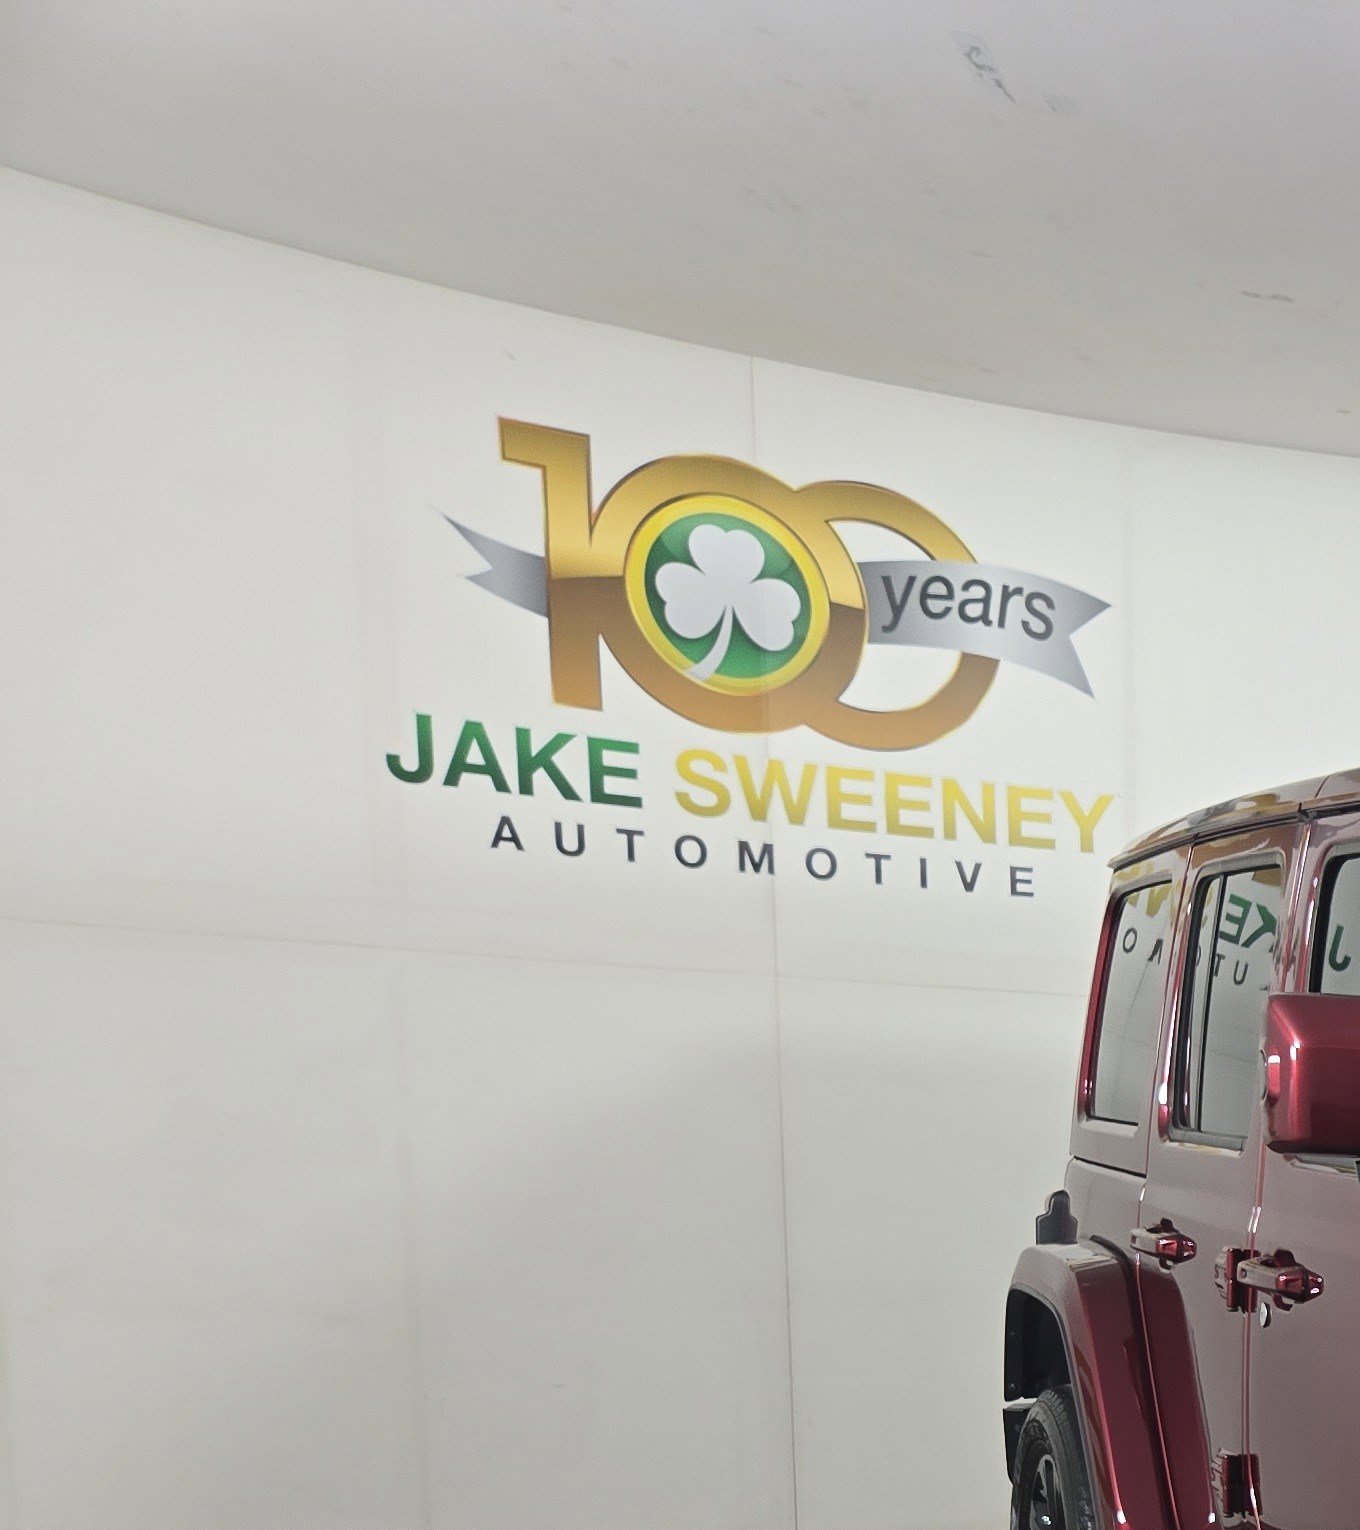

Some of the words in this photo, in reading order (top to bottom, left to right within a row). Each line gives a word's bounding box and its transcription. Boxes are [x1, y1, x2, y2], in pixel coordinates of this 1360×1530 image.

[497, 415, 1001, 752] 100
[880, 572, 1057, 642] years
[385, 712, 643, 809] JAKE
[673, 747, 1115, 854] SWEENEY
[490, 815, 1035, 898] AUTOMOTIVE
